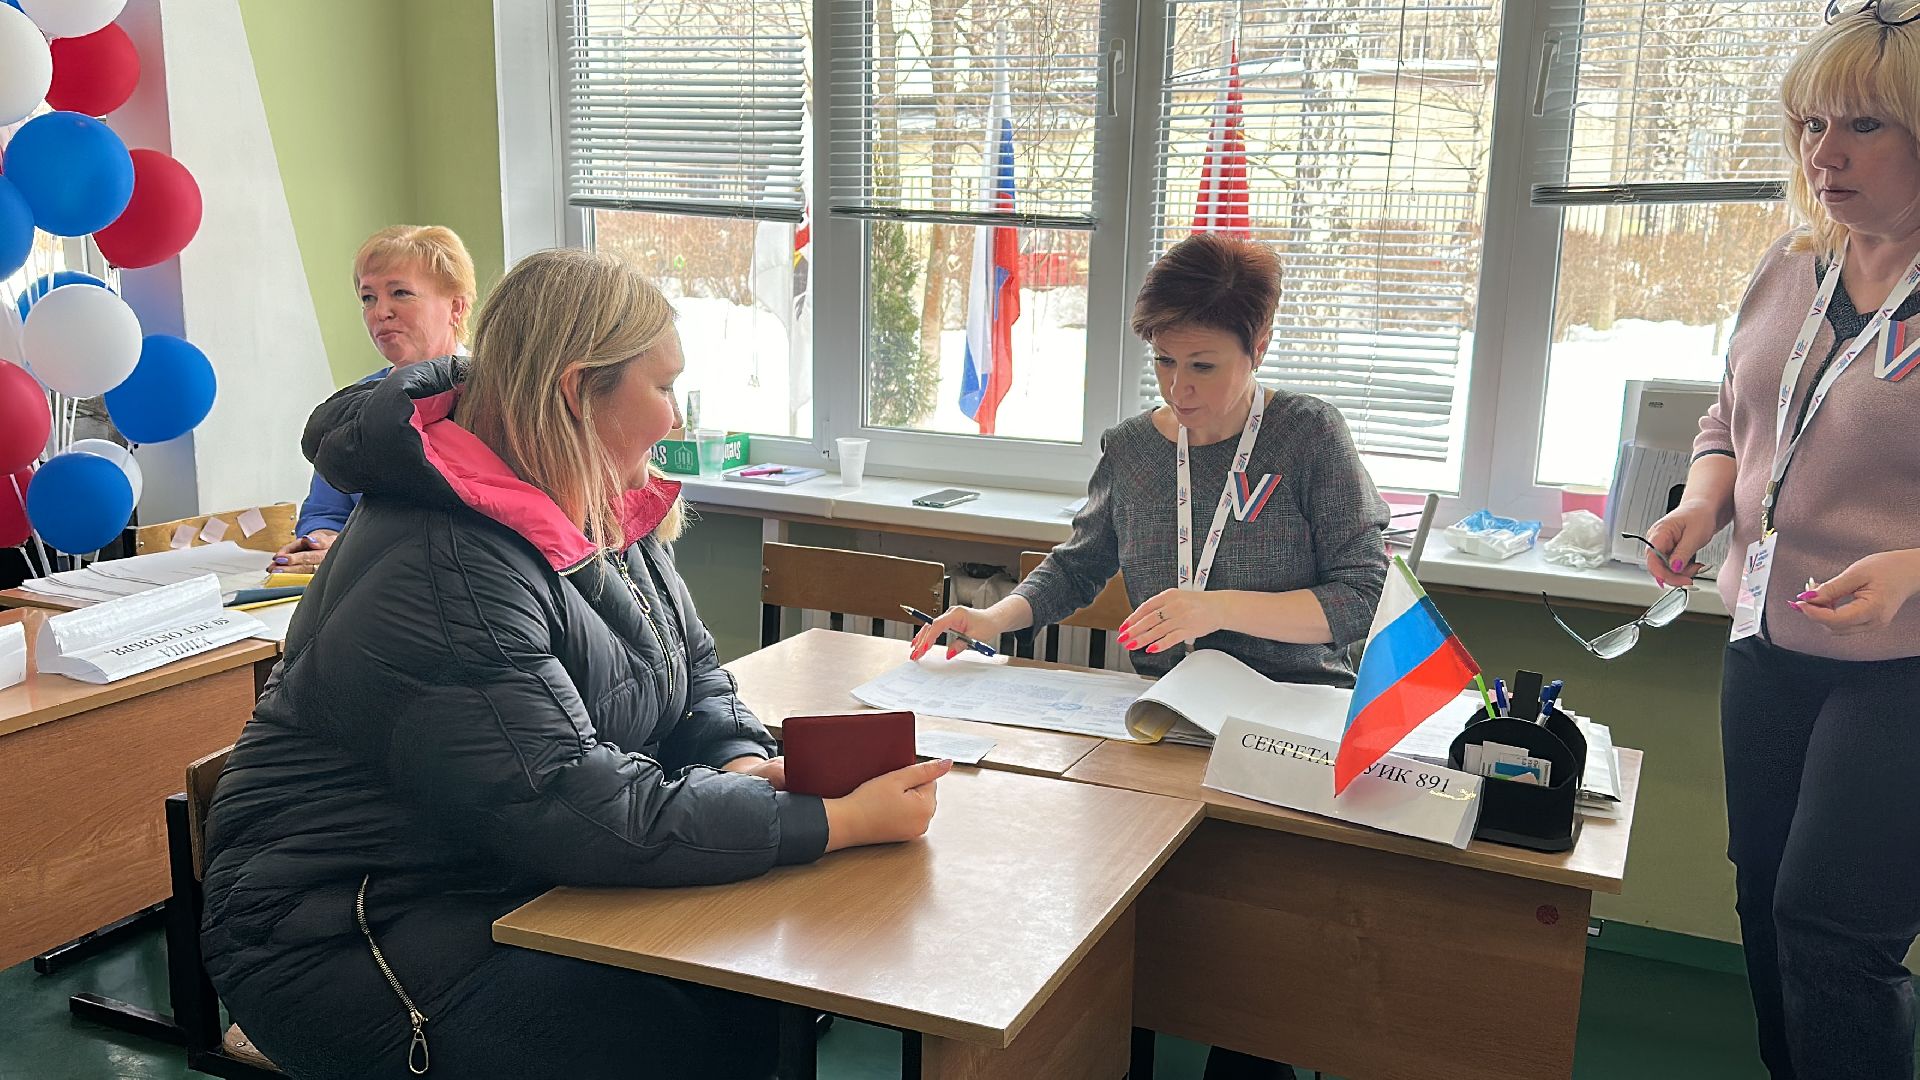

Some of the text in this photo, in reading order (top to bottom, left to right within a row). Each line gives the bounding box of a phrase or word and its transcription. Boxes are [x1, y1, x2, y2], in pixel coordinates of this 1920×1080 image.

[183, 621, 212, 634] ЛЕТ
[159, 637, 213, 657] УЛИЦА
[1241, 732, 1451, 793] СЕКРЕТА УИК 891
